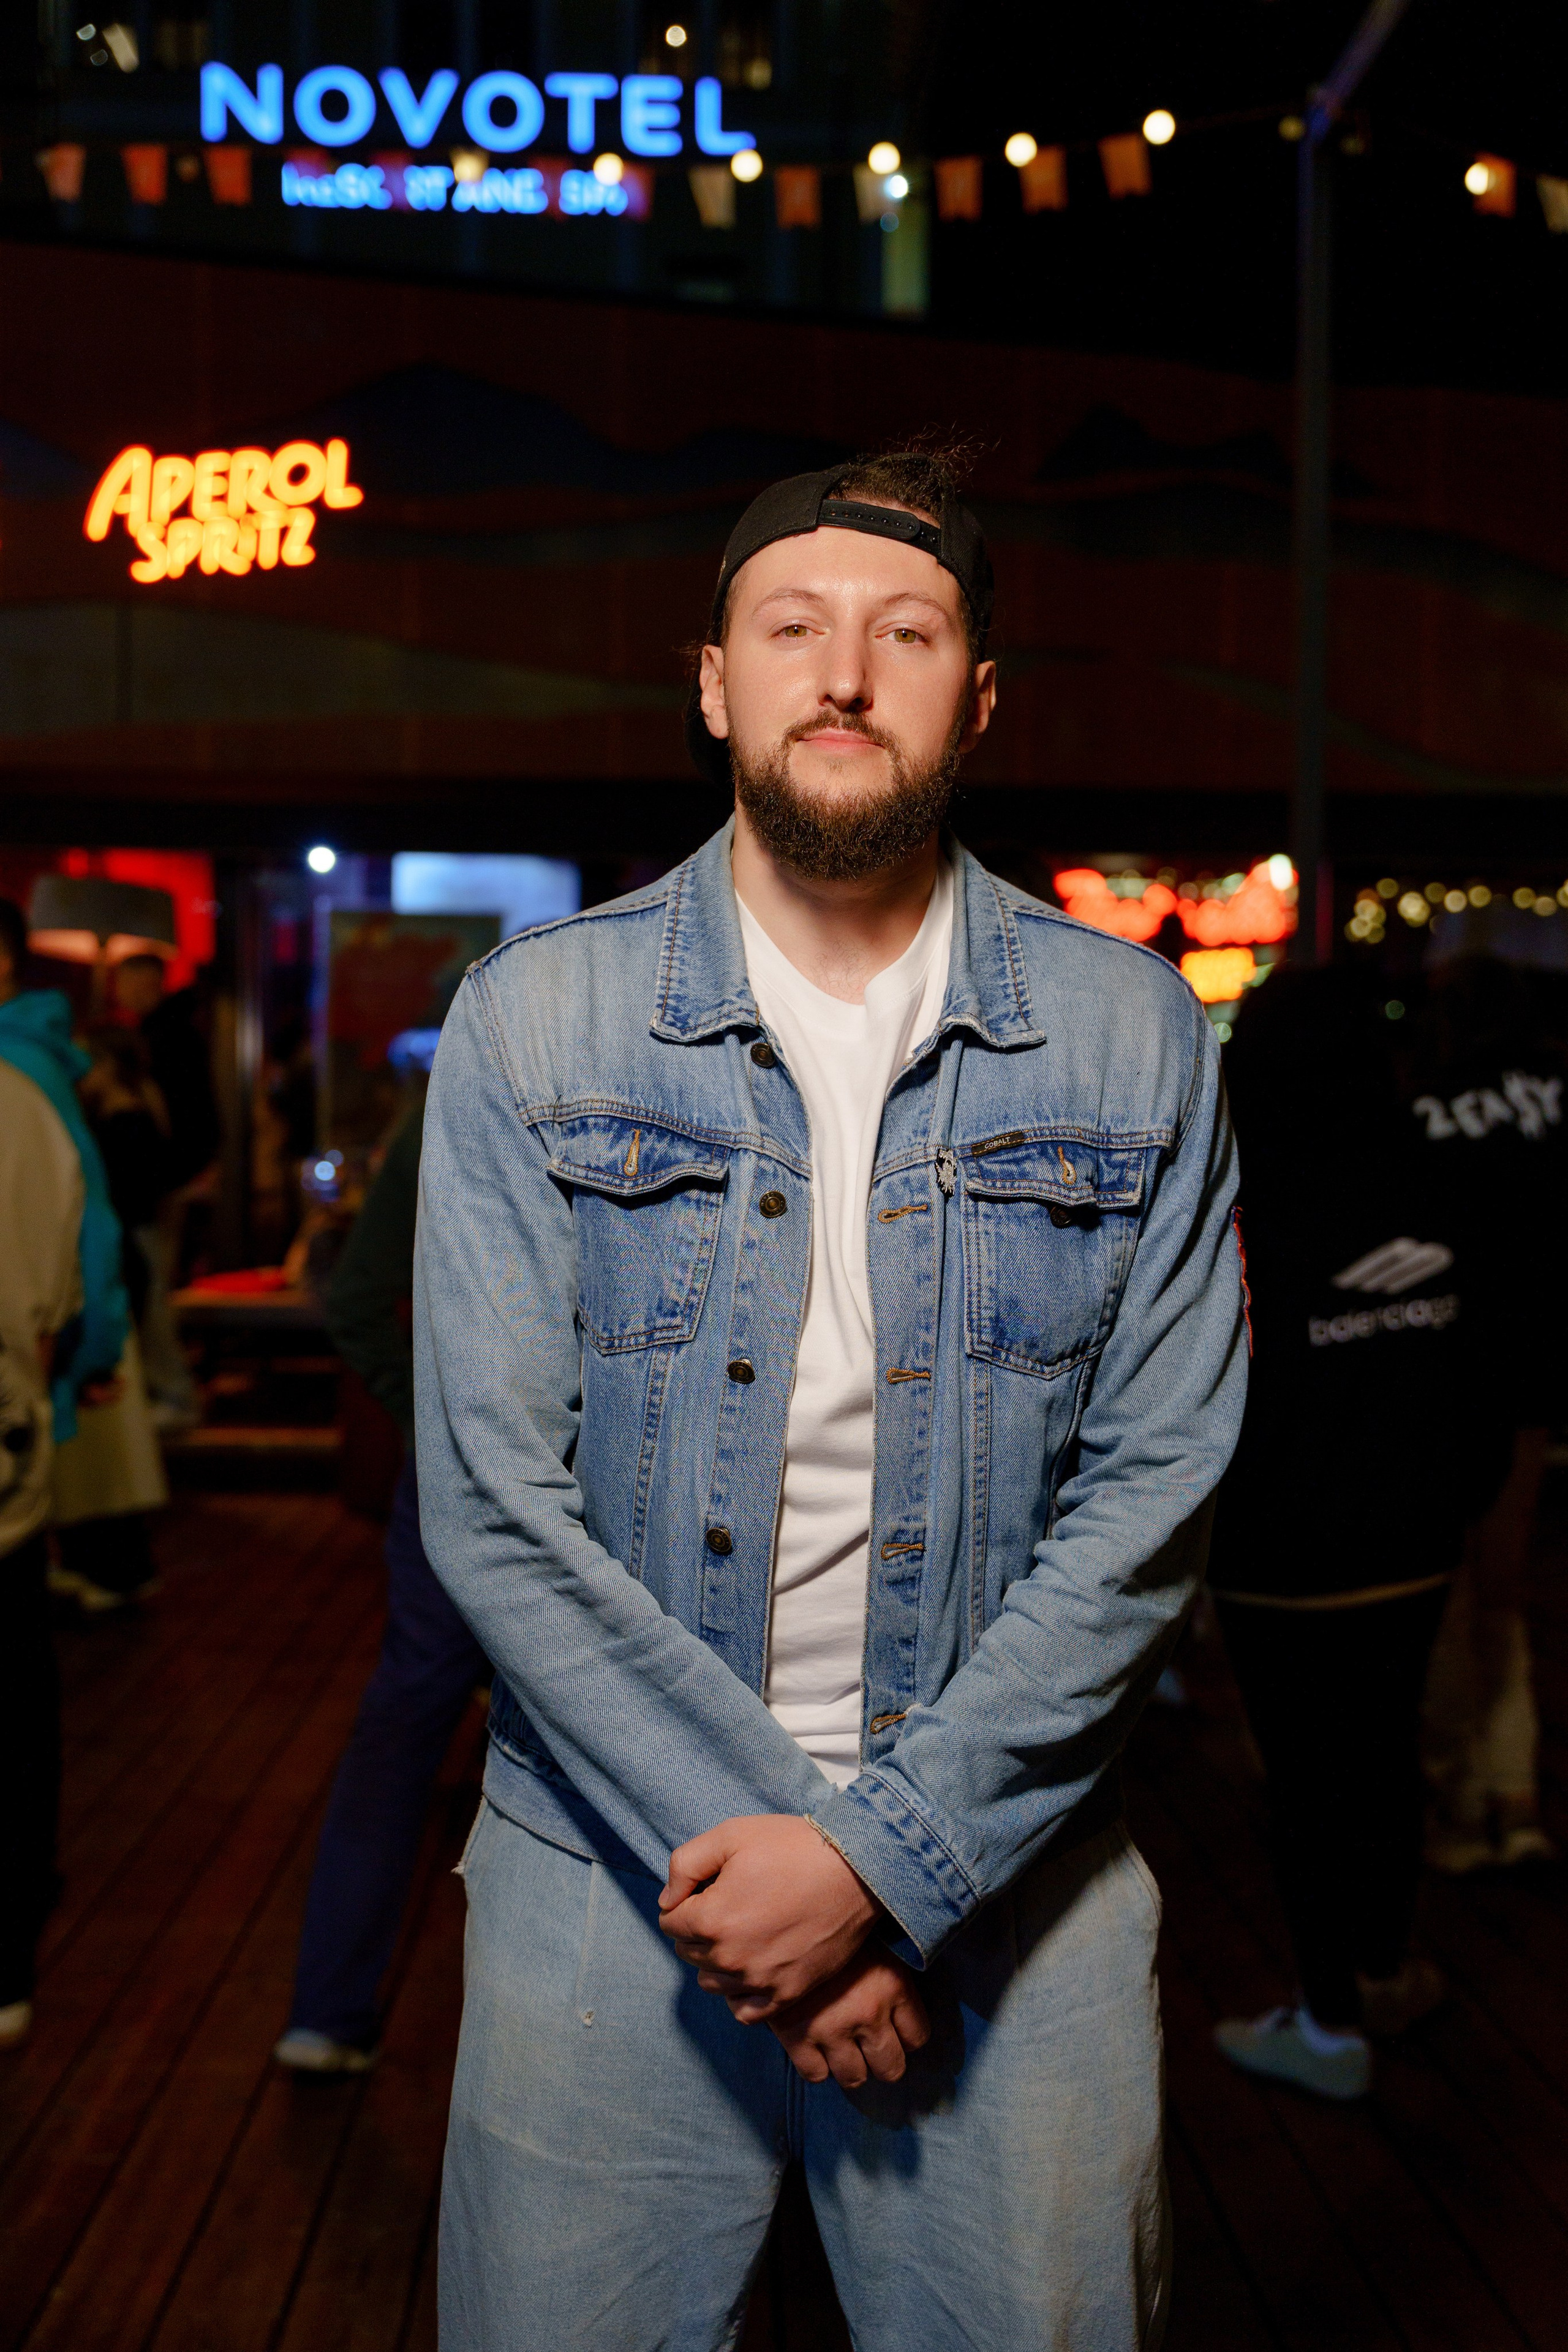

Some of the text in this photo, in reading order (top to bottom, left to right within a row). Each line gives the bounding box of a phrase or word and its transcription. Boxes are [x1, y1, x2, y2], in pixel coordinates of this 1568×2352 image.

[200, 61, 756, 157] NOVOTEL
[84, 437, 363, 542] APEROL
[127, 507, 316, 583] SPRITZ
[984, 1137, 1011, 1149] COBALT
